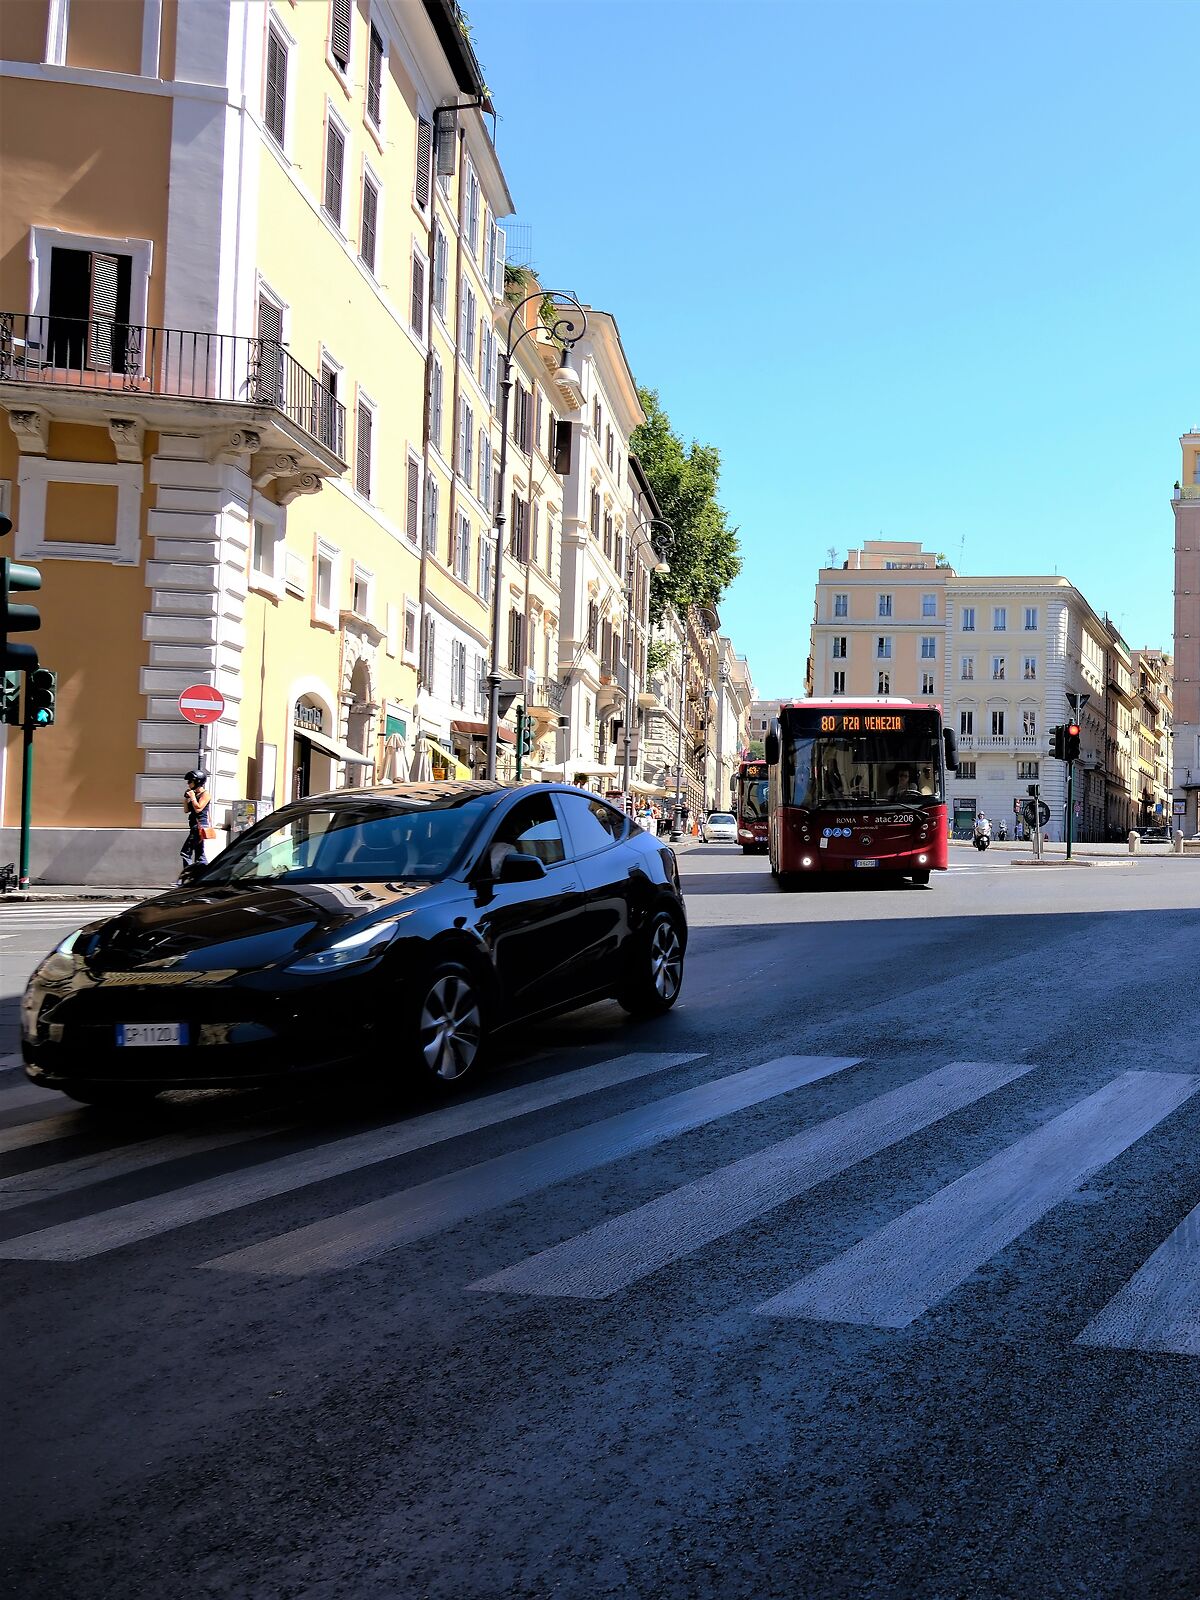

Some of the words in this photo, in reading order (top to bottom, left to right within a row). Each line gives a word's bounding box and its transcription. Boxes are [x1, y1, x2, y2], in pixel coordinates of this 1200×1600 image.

[821, 716, 836, 731] 80
[843, 716, 860, 730] PZA
[864, 716, 902, 730] VENEZIA
[874, 815, 892, 823] atac
[893, 814, 914, 823] 2206
